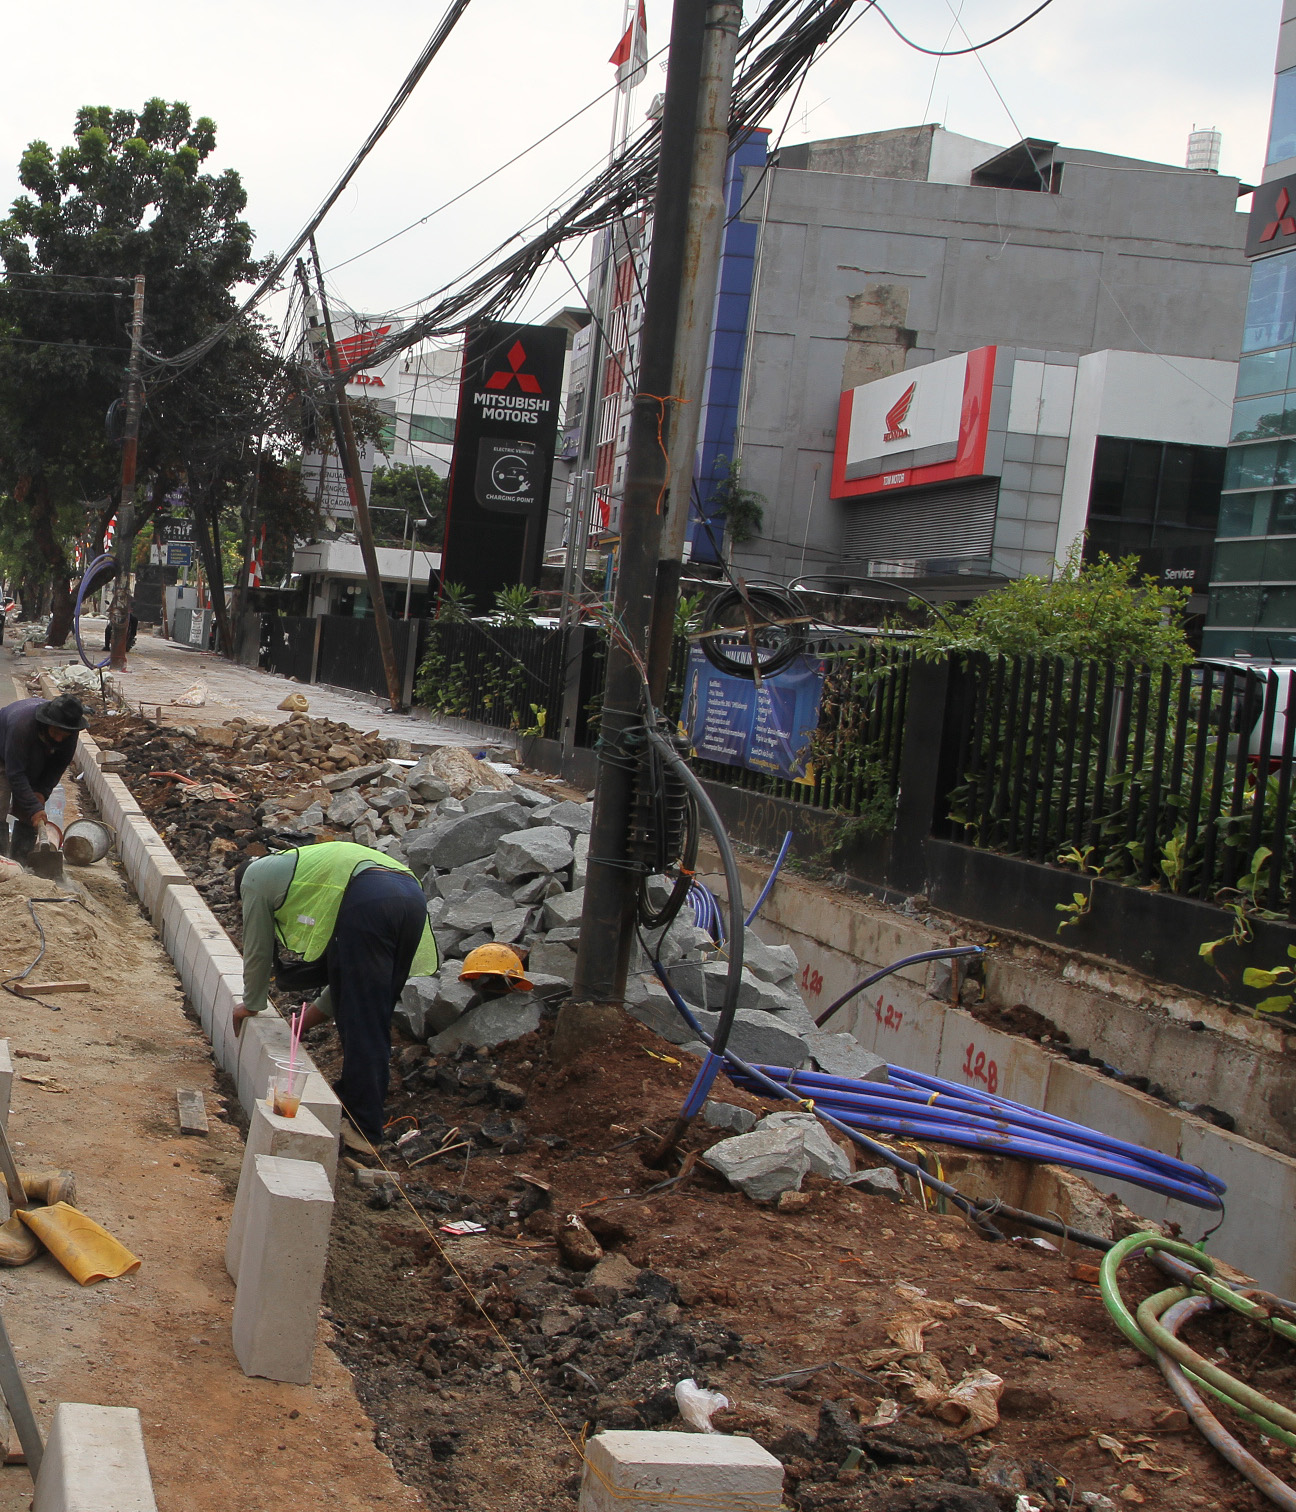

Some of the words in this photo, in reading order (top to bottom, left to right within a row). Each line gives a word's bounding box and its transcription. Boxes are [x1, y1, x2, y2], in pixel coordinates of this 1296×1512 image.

[473, 392, 550, 412] MITSUBISHI
[482, 407, 539, 424] MOTORS
[883, 428, 910, 442] HONDA
[485, 493, 516, 502] CHARGING
[516, 496, 535, 504] POINT
[1164, 567, 1196, 580] Service
[875, 994, 903, 1032] 127
[962, 1042, 998, 1094] 128
